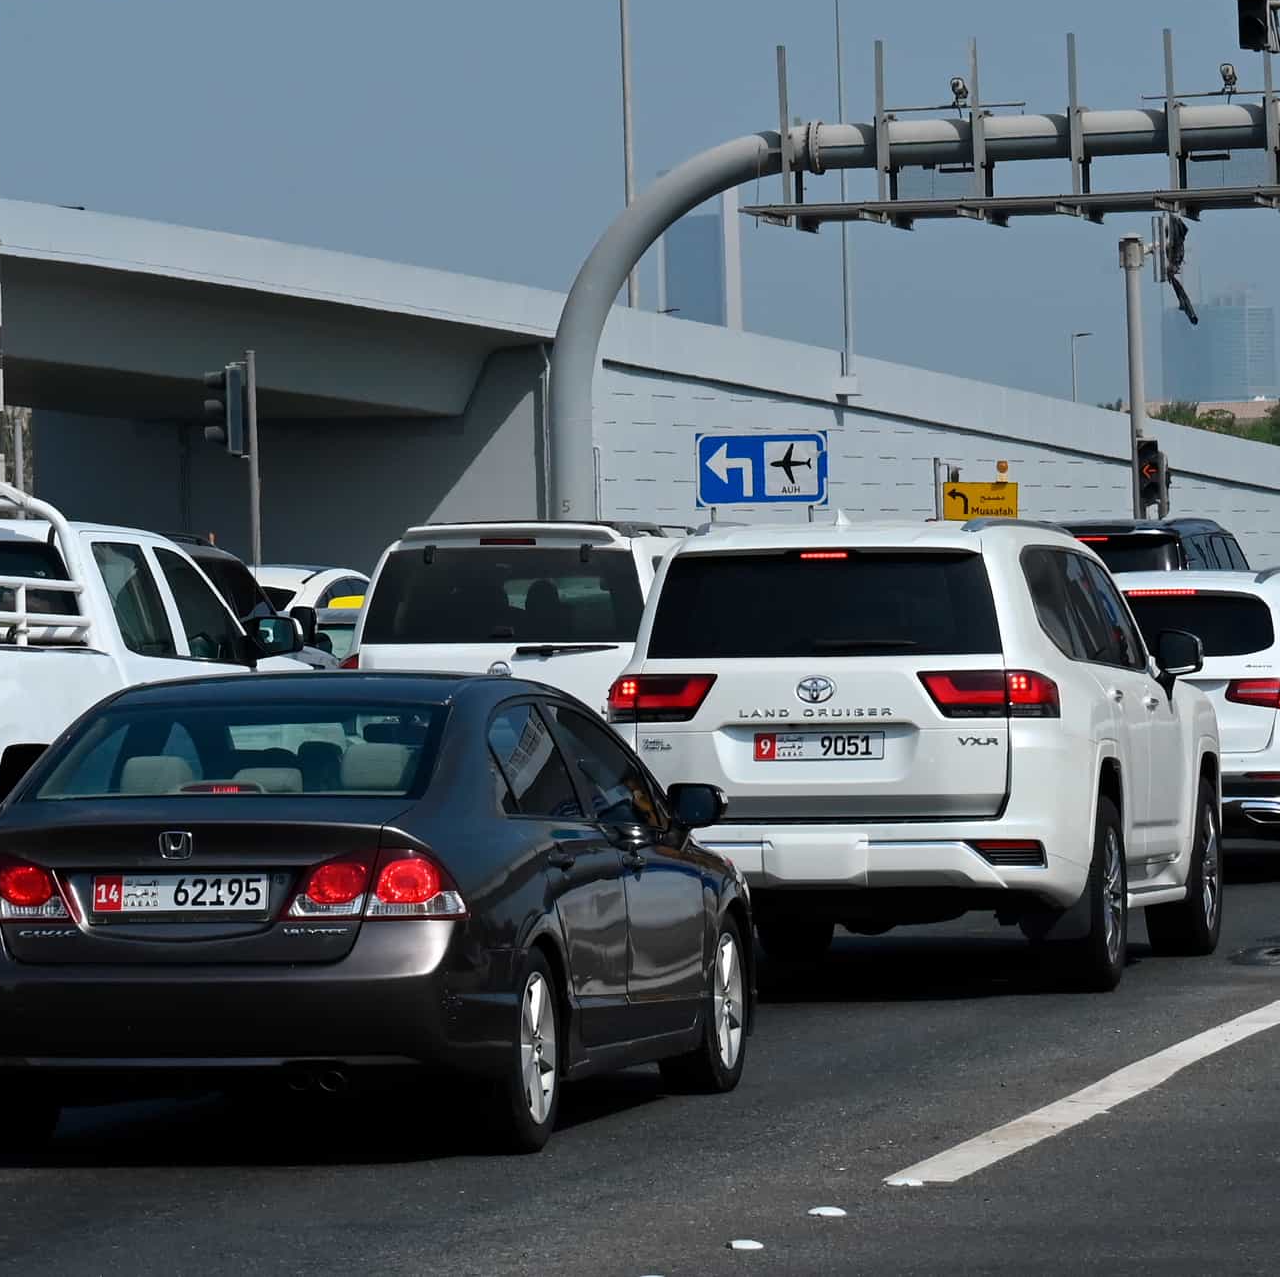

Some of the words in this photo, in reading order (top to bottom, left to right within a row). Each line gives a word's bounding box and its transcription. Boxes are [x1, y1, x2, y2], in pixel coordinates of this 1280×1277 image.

[782, 485, 801, 494] AUH
[971, 506, 1014, 516] Mussafah
[738, 708, 791, 719] LAND
[803, 707, 894, 718] CRUISER
[760, 738, 771, 756] 9
[820, 734, 873, 757] 9051
[957, 736, 999, 746] VXR
[97, 883, 120, 904] 14
[173, 877, 262, 907] 62195
